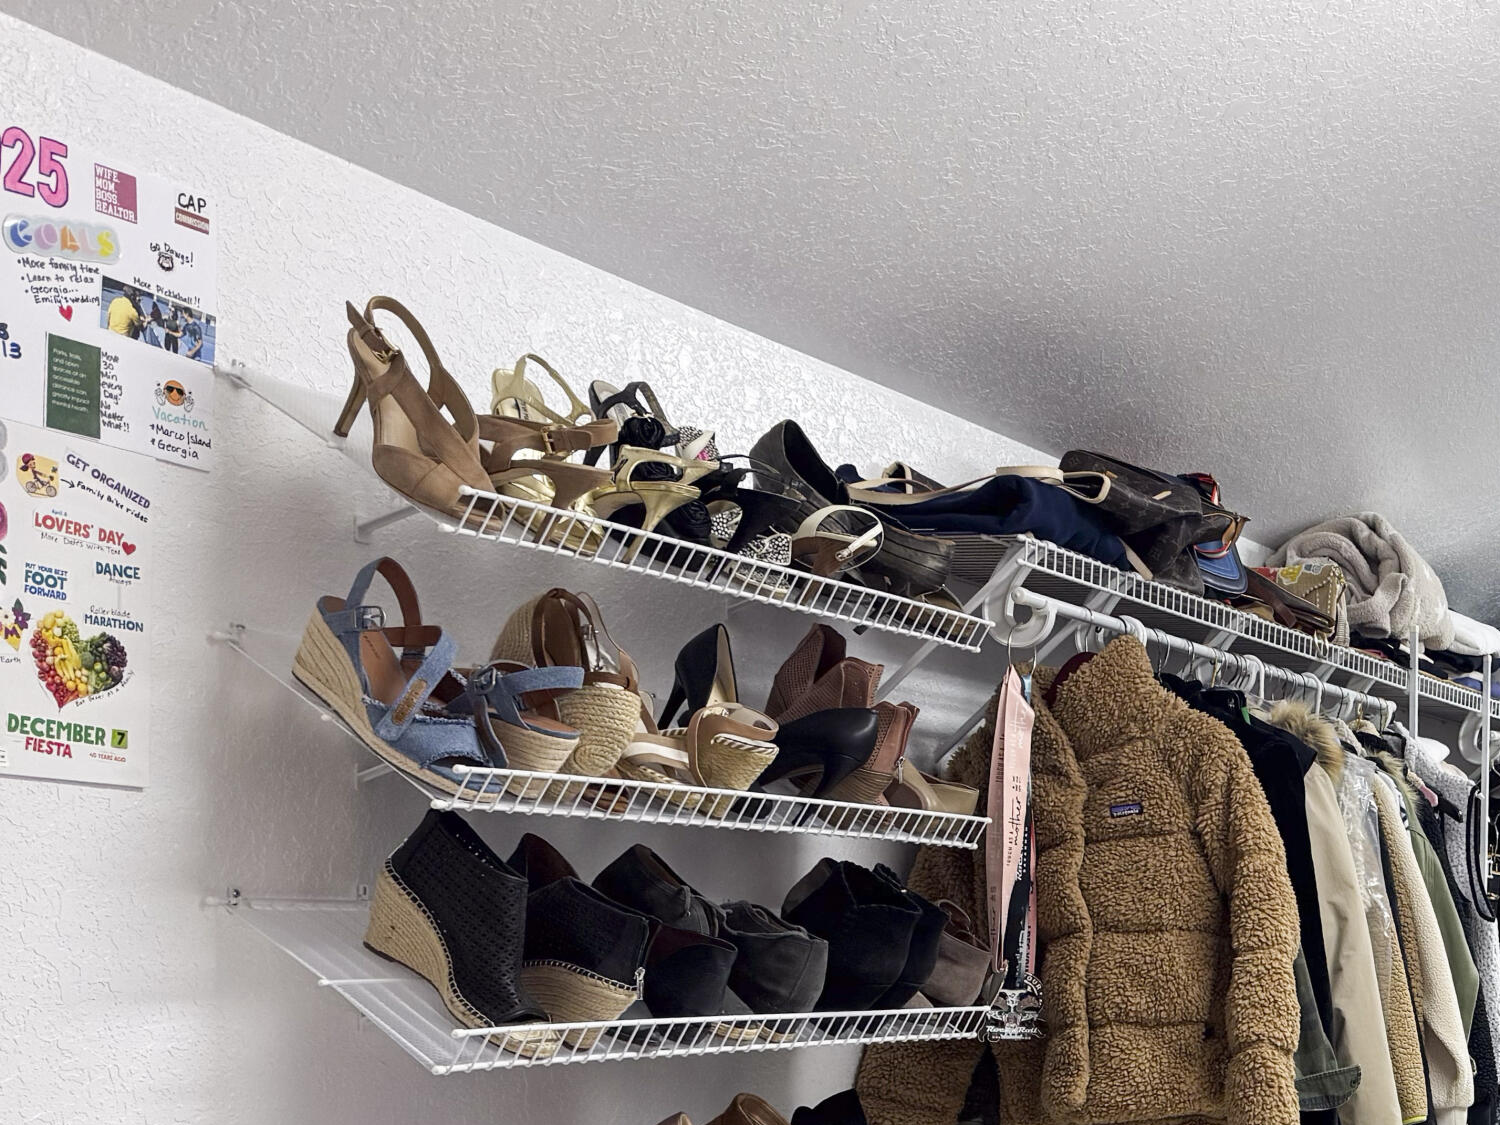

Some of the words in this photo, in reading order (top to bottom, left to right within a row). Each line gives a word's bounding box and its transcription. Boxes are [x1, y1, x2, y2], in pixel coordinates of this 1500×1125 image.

[95, 165, 120, 183] WIFE.
[95, 177, 117, 194] MOM.
[95, 188, 120, 206] BOSS.
[177, 192, 207, 213] CAP
[96, 200, 137, 222] REALTOR.
[10, 219, 115, 257] GOALS
[22, 257, 46, 270] More
[49, 258, 78, 277] family
[55, 274, 65, 282] to
[152, 405, 209, 431] Vacation
[156, 423, 186, 441] Marco
[187, 431, 212, 450] Island
[157, 439, 200, 460] Georgia
[66, 453, 90, 472] GET
[91, 468, 151, 510] ORGANIZED
[34, 511, 95, 539] LOVERS'
[98, 527, 125, 546] DAY
[24, 569, 68, 590] FOOT
[95, 561, 141, 580] DANCE
[24, 584, 67, 601] FORWARD
[84, 613, 144, 632] MARATHON
[7, 713, 106, 746] DECEMBER
[117, 731, 126, 746] 7
[25, 736, 73, 759] FIESTA
